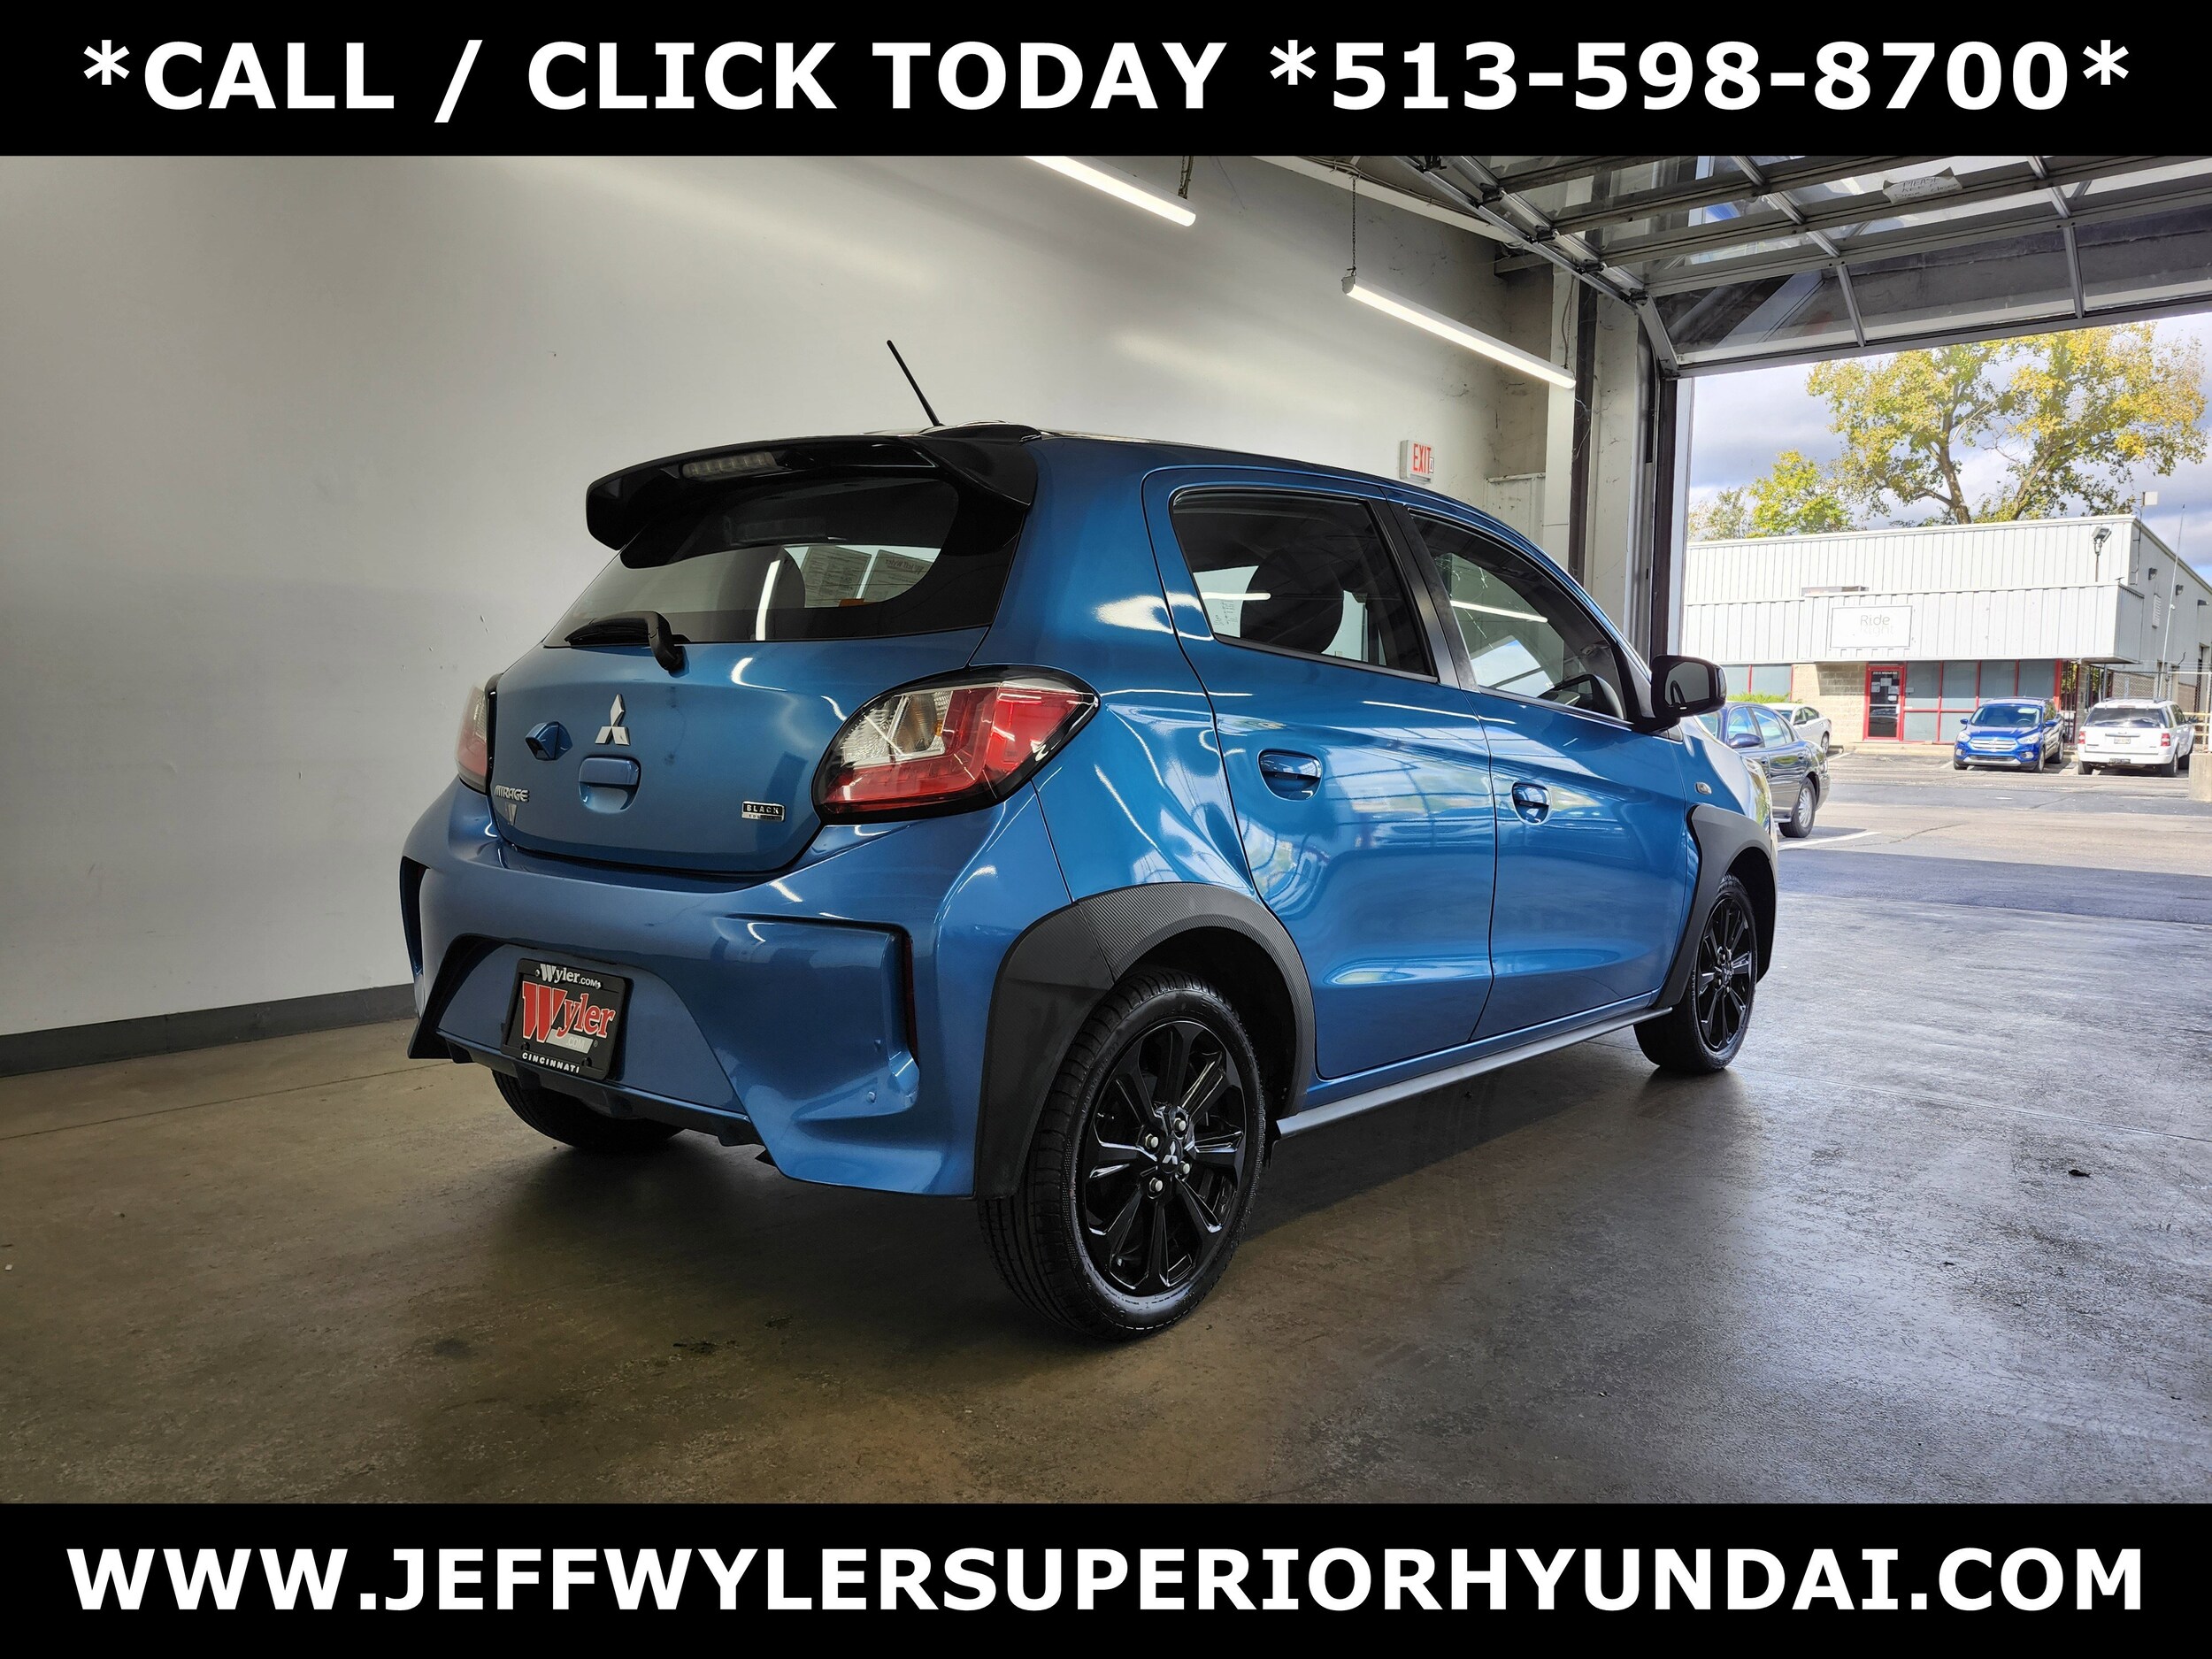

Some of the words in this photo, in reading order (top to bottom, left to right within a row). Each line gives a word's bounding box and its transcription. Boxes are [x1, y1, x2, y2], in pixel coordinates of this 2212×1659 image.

[1413, 443, 1431, 474] EXIT
[1860, 613, 1891, 626] Ride
[495, 784, 529, 802] MIRAGE
[746, 804, 779, 814] BLACK
[522, 980, 616, 1043] Wyler
[522, 1052, 580, 1074] CINCINNATI
